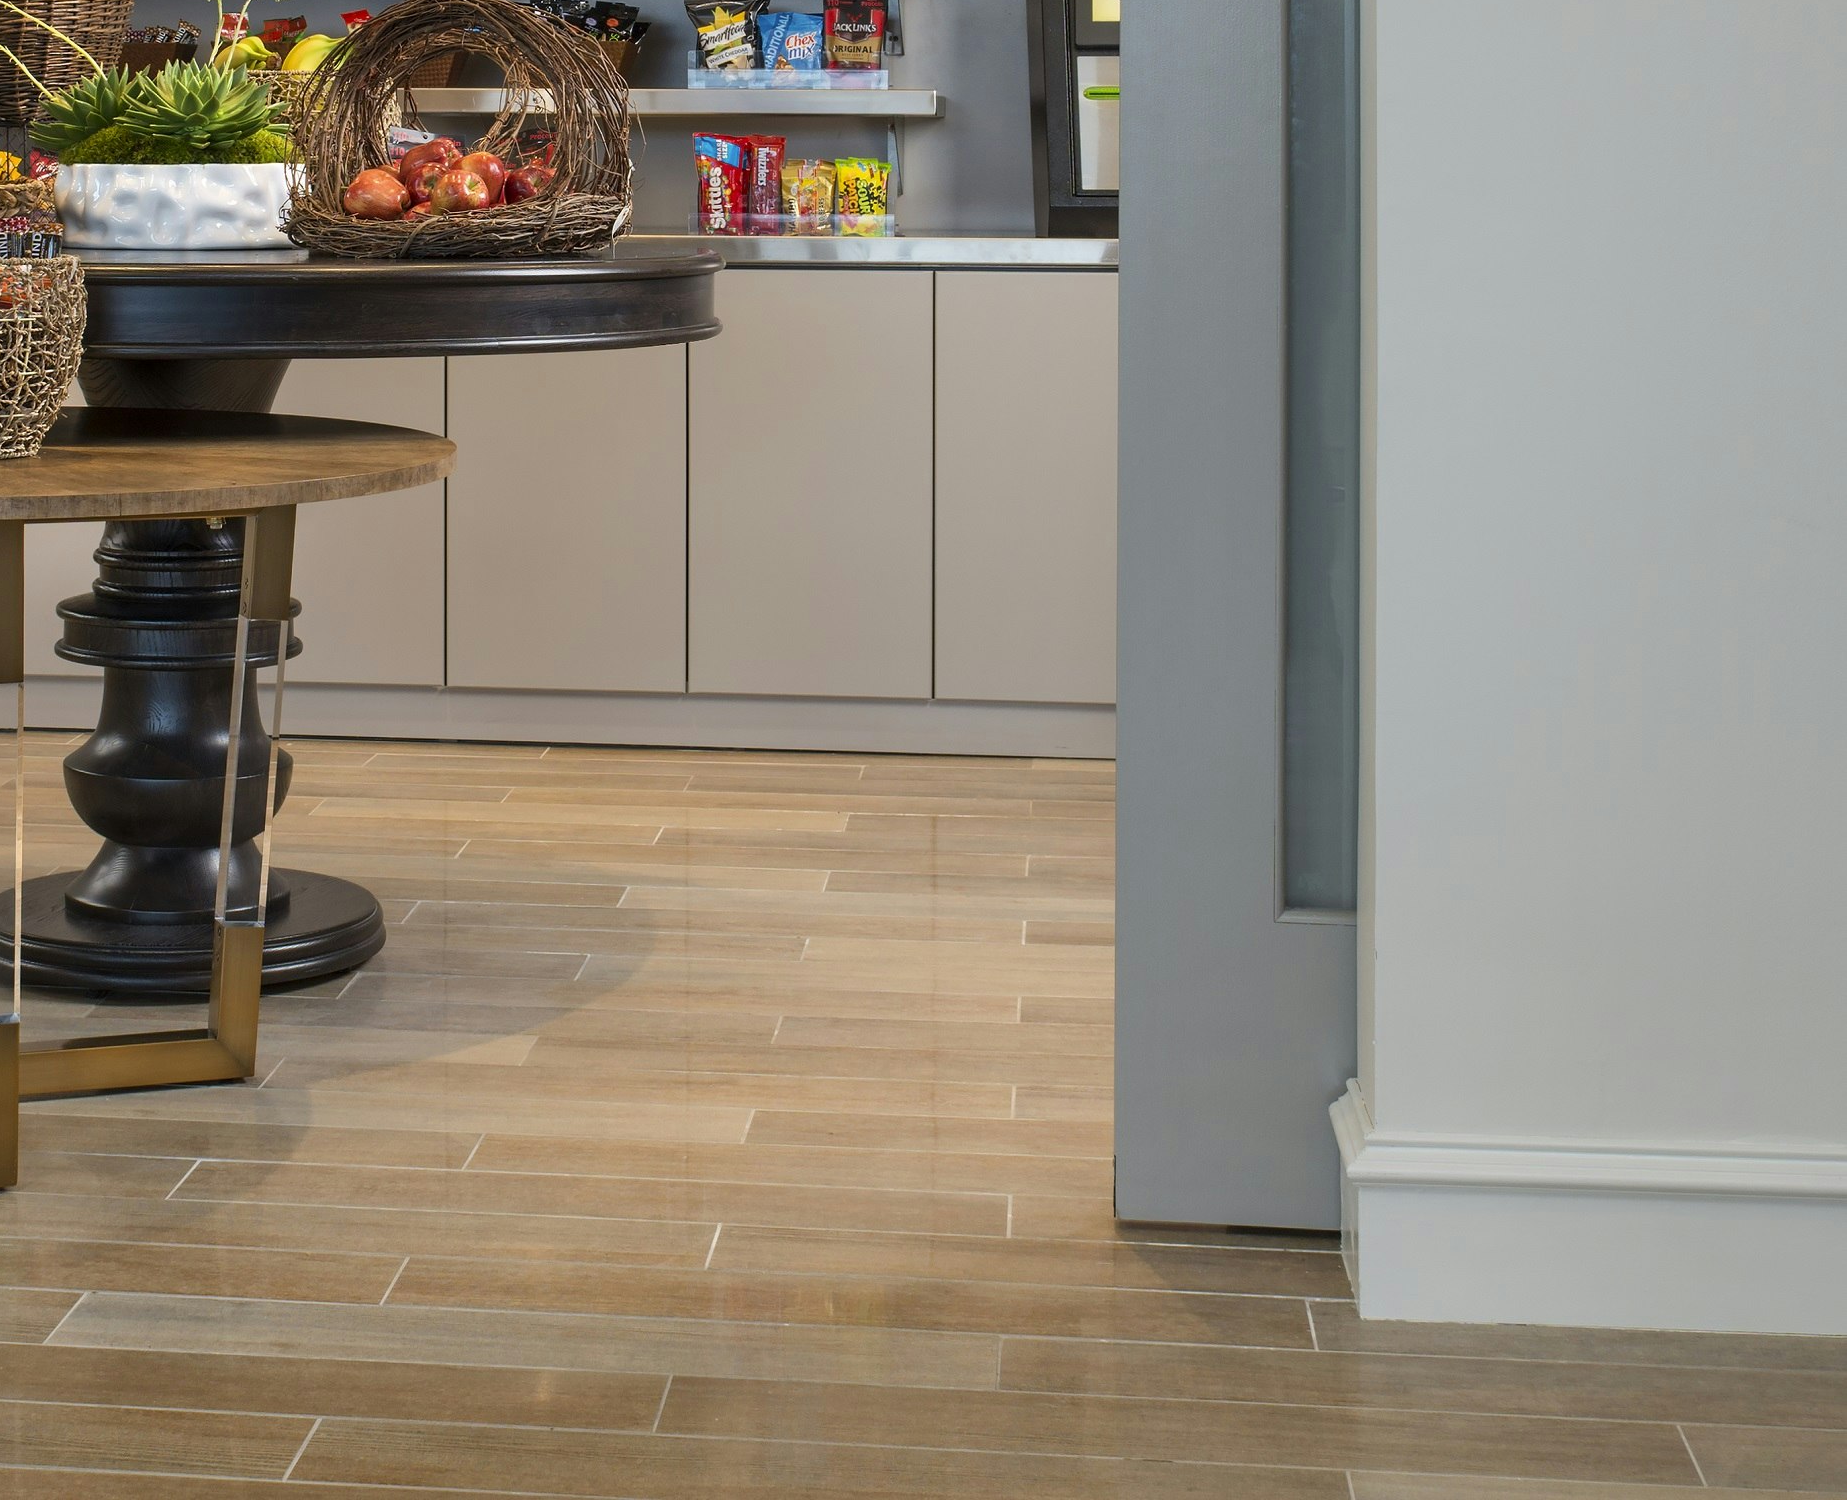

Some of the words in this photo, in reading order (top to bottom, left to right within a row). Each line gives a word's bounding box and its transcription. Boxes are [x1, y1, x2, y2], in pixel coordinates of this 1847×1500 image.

[833, 23, 852, 32] JACK
[852, 23, 877, 32] LINK'S
[785, 32, 816, 49] Chex
[709, 54, 725, 65] WHITE
[725, 47, 748, 58] CHEDDAR
[788, 48, 813, 60] mix
[758, 147, 770, 186] Twizzlers
[709, 167, 727, 229] Skittles
[845, 180, 859, 214] PATCH
[856, 180, 871, 214] SOUR
[32, 233, 42, 257] IND
